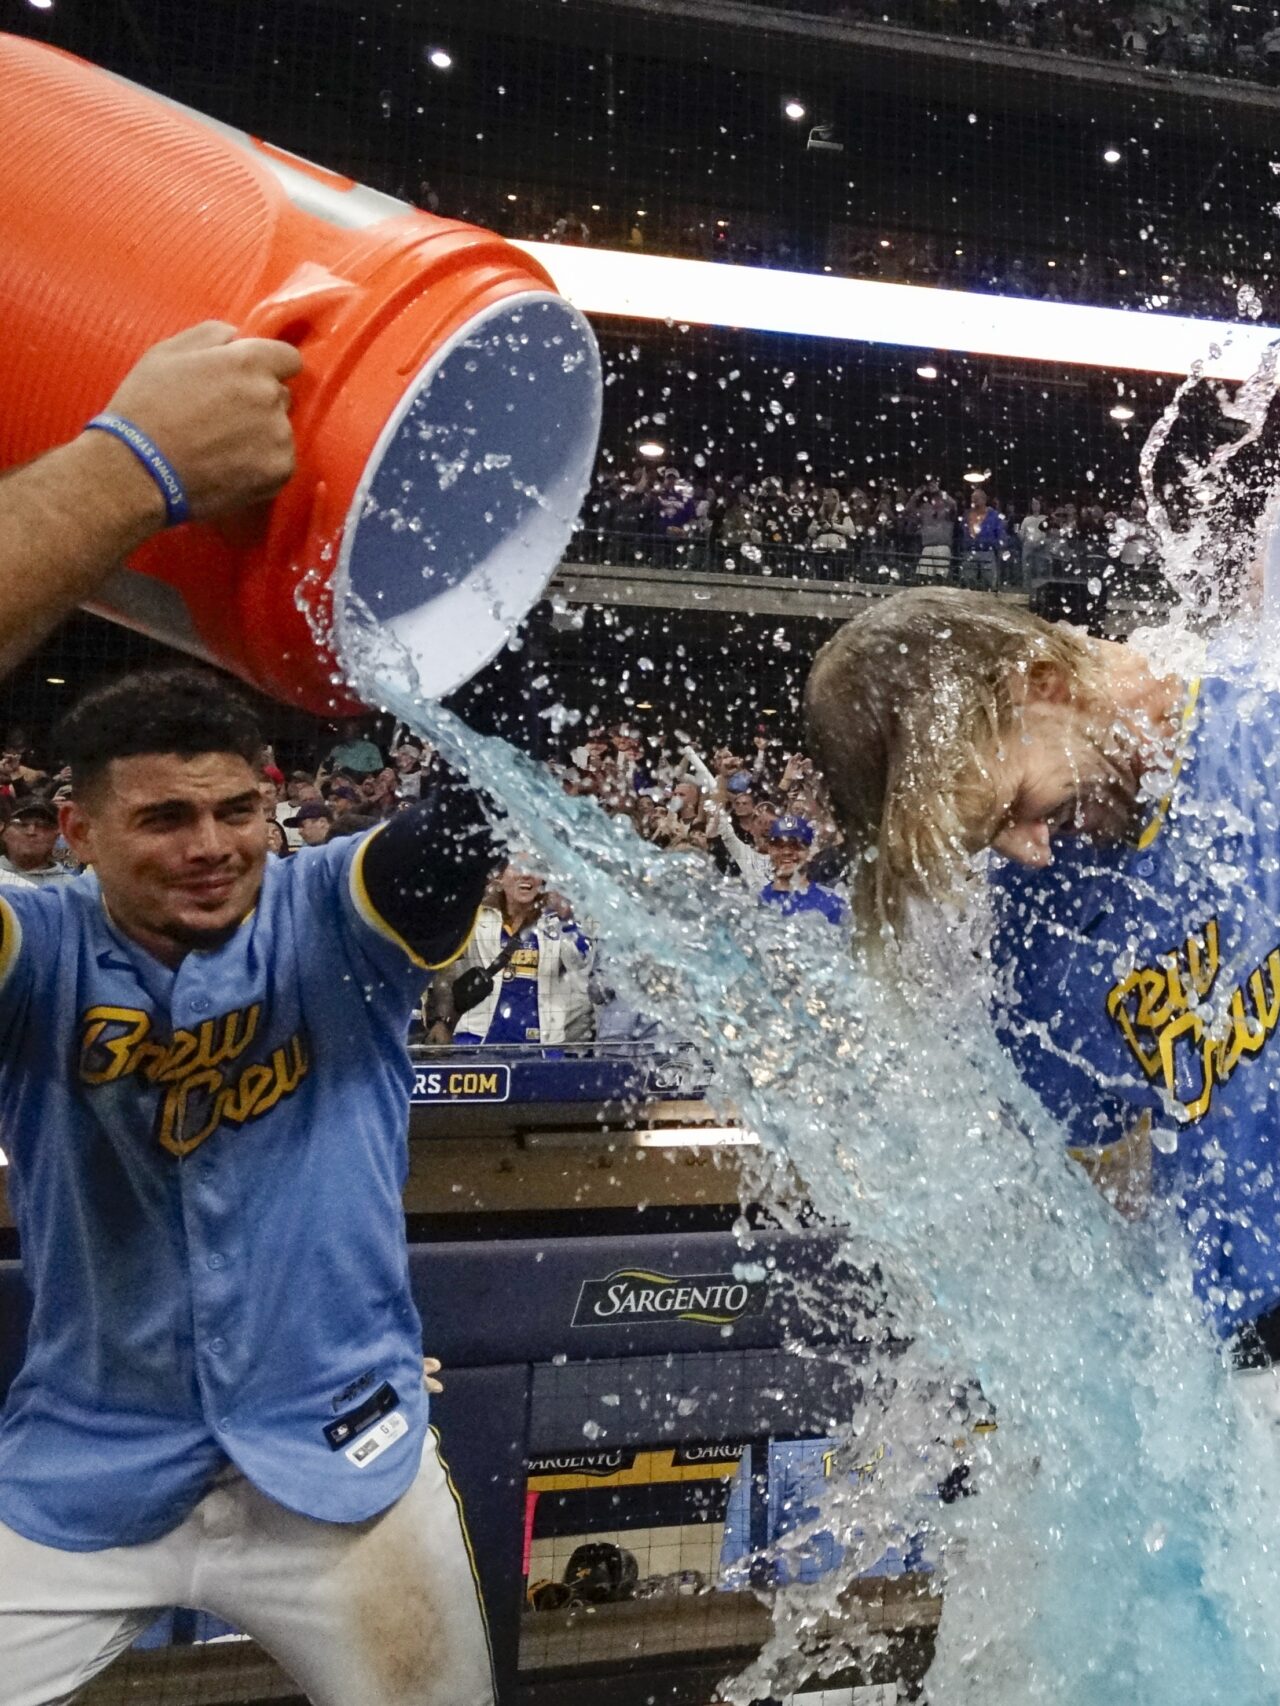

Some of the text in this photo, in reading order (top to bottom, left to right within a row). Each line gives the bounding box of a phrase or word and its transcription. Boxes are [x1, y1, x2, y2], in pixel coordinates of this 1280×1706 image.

[151, 456, 179, 493] DOWN
[80, 1002, 262, 1084] Brew
[158, 1032, 310, 1157] Crew
[594, 1282, 748, 1316] SARGENTO
[528, 1449, 621, 1470] ARGENTO
